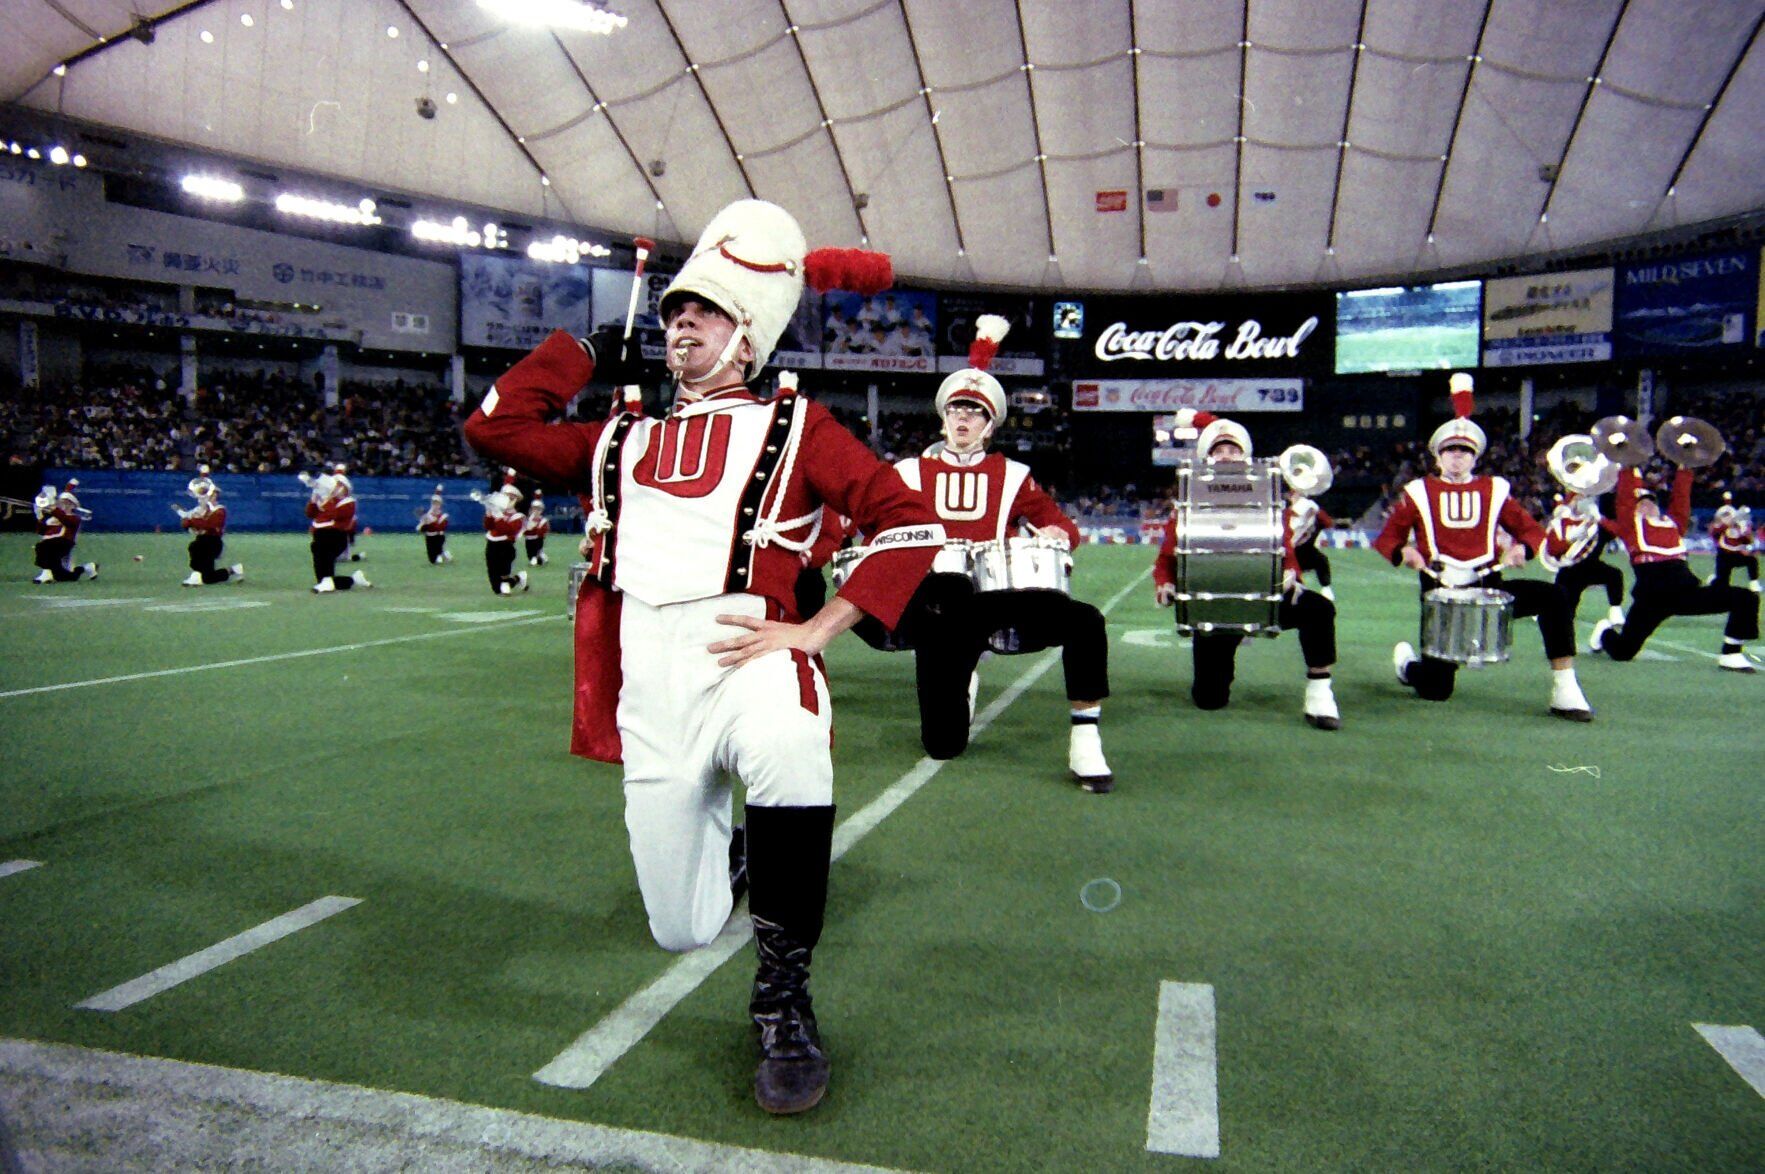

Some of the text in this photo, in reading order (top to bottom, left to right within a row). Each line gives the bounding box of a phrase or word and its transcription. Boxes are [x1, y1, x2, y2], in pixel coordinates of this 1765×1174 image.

[1095, 315, 1319, 361] Coca-Cola Bowl
[935, 472, 988, 520] W
[1206, 483, 1254, 494] YAMAHA
[1439, 490, 1481, 529] W
[874, 529, 934, 546] WISCONSIN
